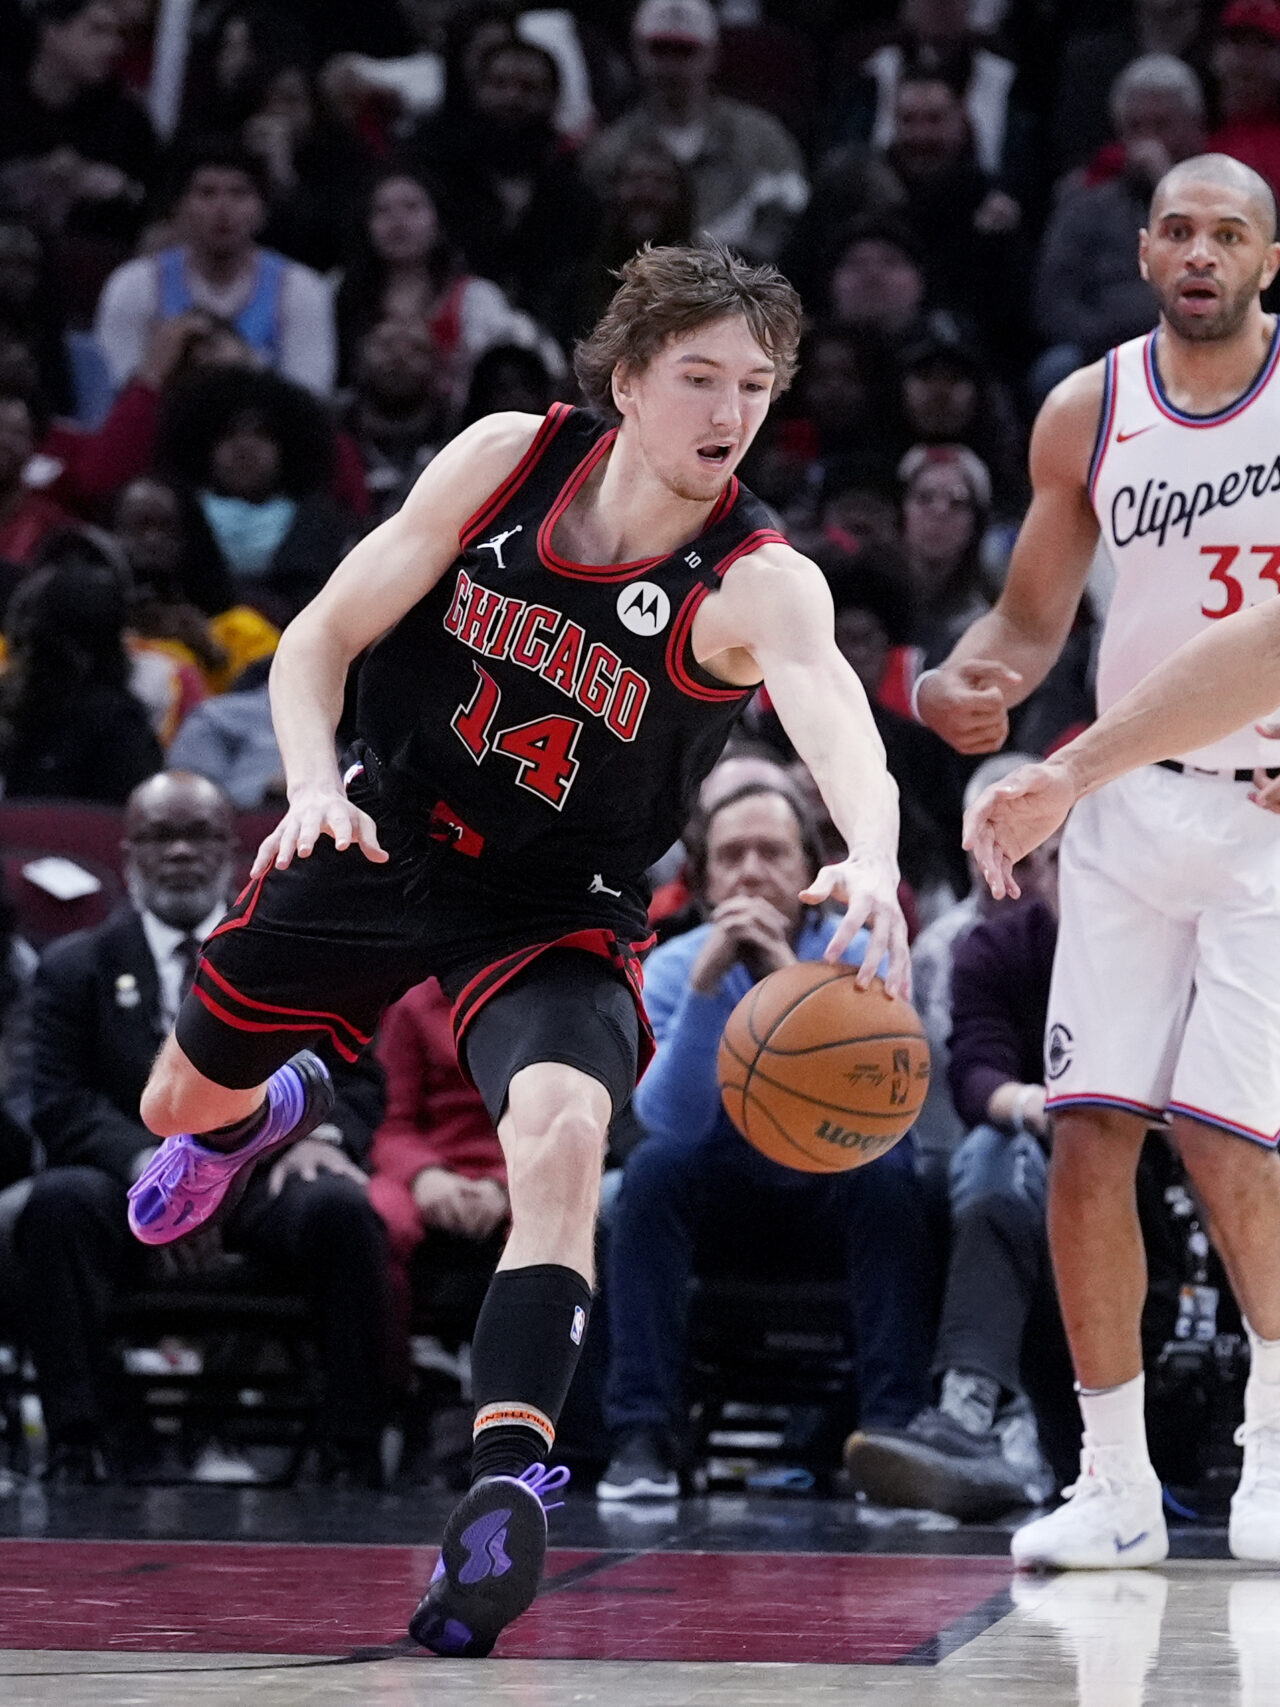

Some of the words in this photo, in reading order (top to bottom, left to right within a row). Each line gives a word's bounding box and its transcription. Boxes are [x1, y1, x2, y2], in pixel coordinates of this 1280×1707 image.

[684, 551, 702, 568] 10
[443, 569, 650, 742] CHICAGO
[450, 659, 583, 811] 14
